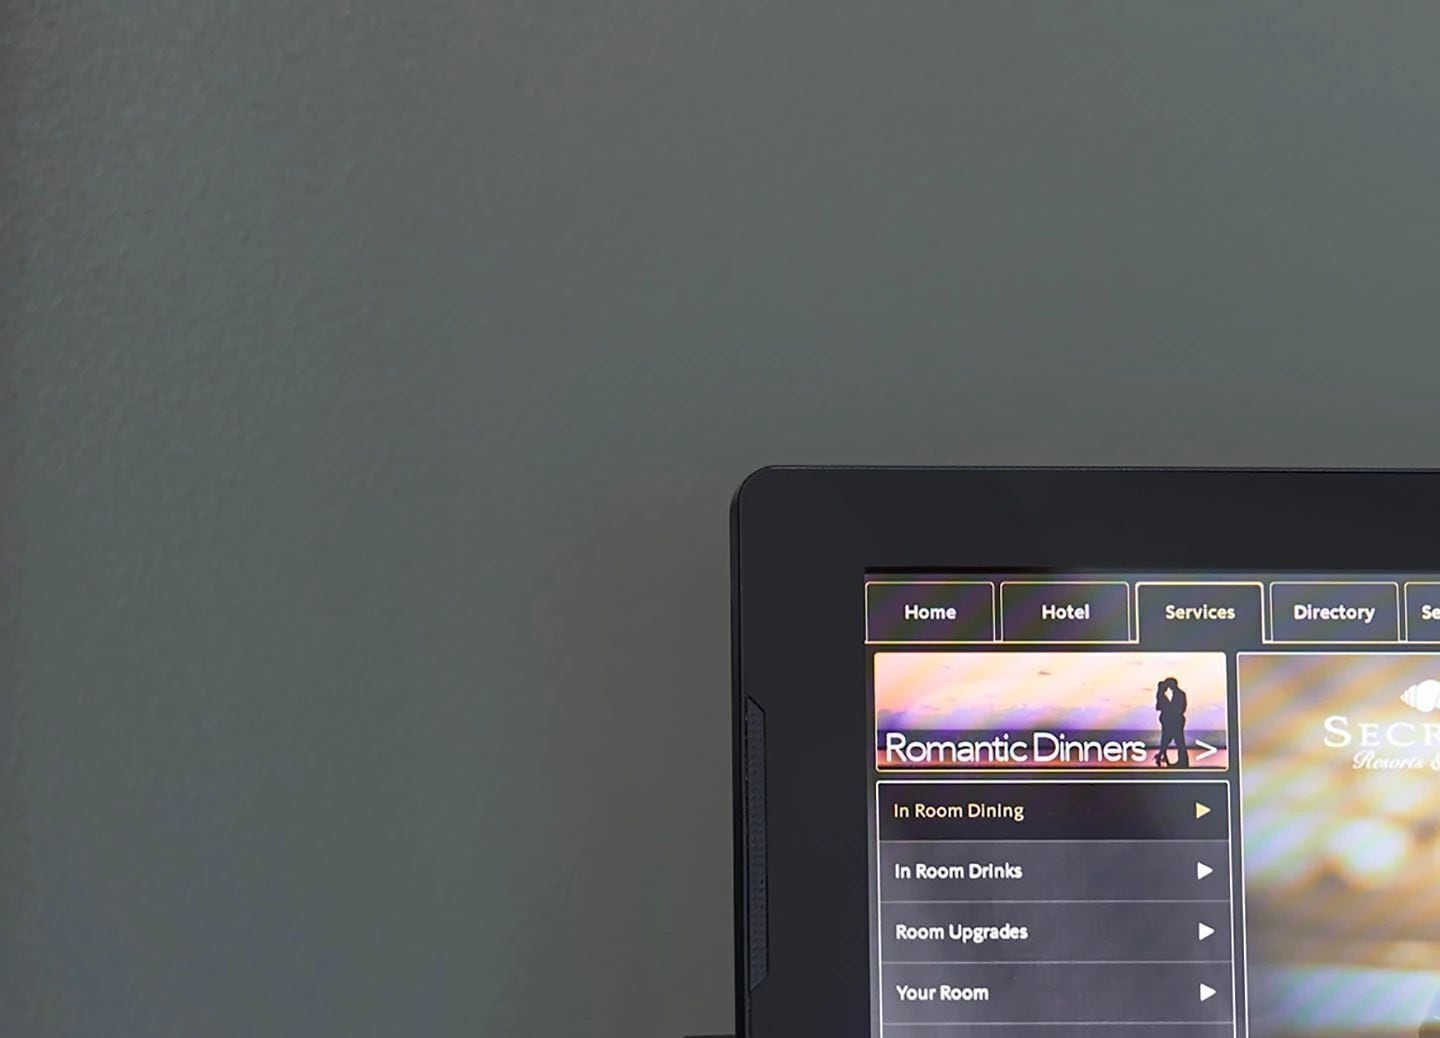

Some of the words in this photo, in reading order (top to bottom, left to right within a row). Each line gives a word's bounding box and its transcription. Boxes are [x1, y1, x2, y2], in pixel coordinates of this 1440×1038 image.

[904, 604, 957, 621] Home
[1041, 603, 1090, 621] Hotel
[1165, 604, 1236, 621] Services
[1293, 603, 1376, 625] Directory
[885, 731, 1027, 764] Romantic
[1033, 732, 1147, 764] Dinners
[1352, 750, 1424, 770] Resorts
[893, 803, 909, 818] In
[914, 803, 963, 818] Room
[967, 803, 1025, 822] Dining
[894, 864, 911, 879] In
[915, 863, 965, 879] Room
[968, 862, 1023, 879] Drinks
[895, 924, 945, 940] Room
[949, 924, 1029, 943] Upgrades
[896, 985, 936, 1001] Your
[940, 985, 989, 1001] Room
